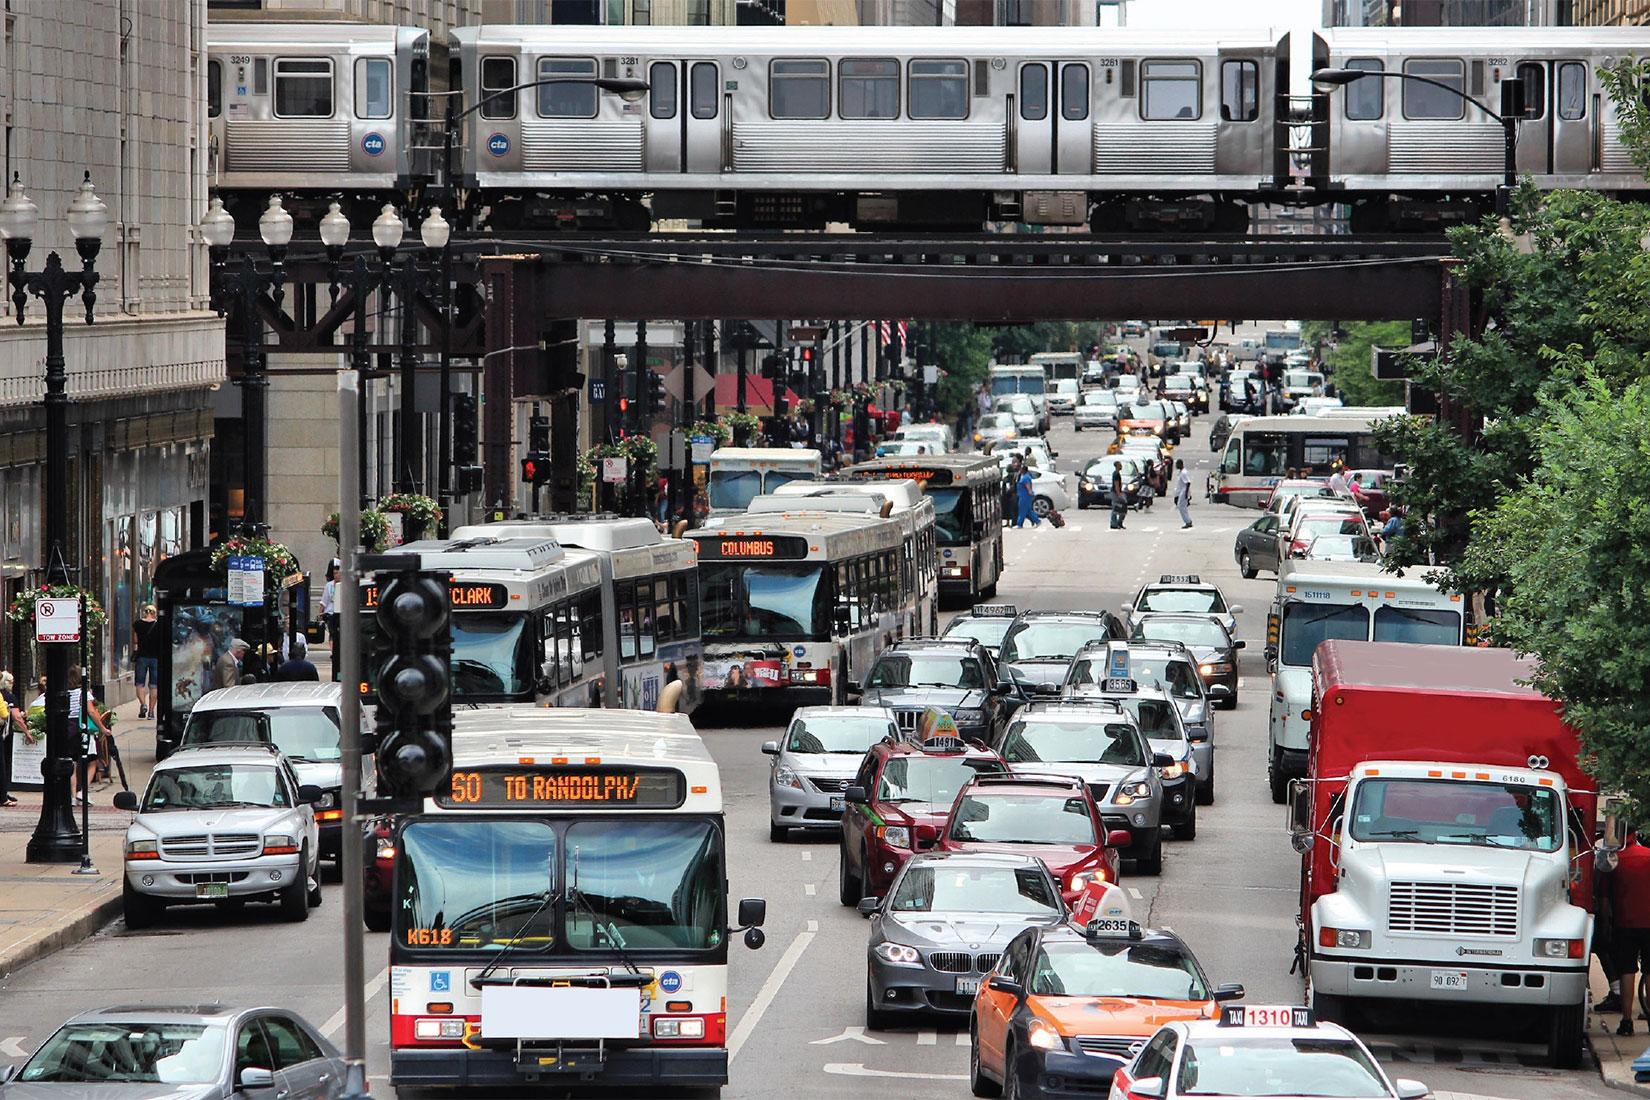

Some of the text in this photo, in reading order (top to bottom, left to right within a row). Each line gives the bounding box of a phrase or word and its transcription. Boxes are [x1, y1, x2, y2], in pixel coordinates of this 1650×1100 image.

[230, 55, 250, 64] 3249
[620, 56, 639, 65] 3281
[1488, 57, 1508, 65] 3282
[365, 141, 382, 149] cta
[490, 141, 507, 149] cta
[721, 541, 774, 555] COLUMBUS
[452, 587, 492, 604] CLARK
[1502, 775, 1526, 783] 6180
[504, 775, 527, 800] TO
[1098, 920, 1127, 931] 2635
[407, 927, 453, 945] K618
[662, 977, 679, 986] cta
[1228, 1009, 1308, 1026] TAXI 1310 TAXI
